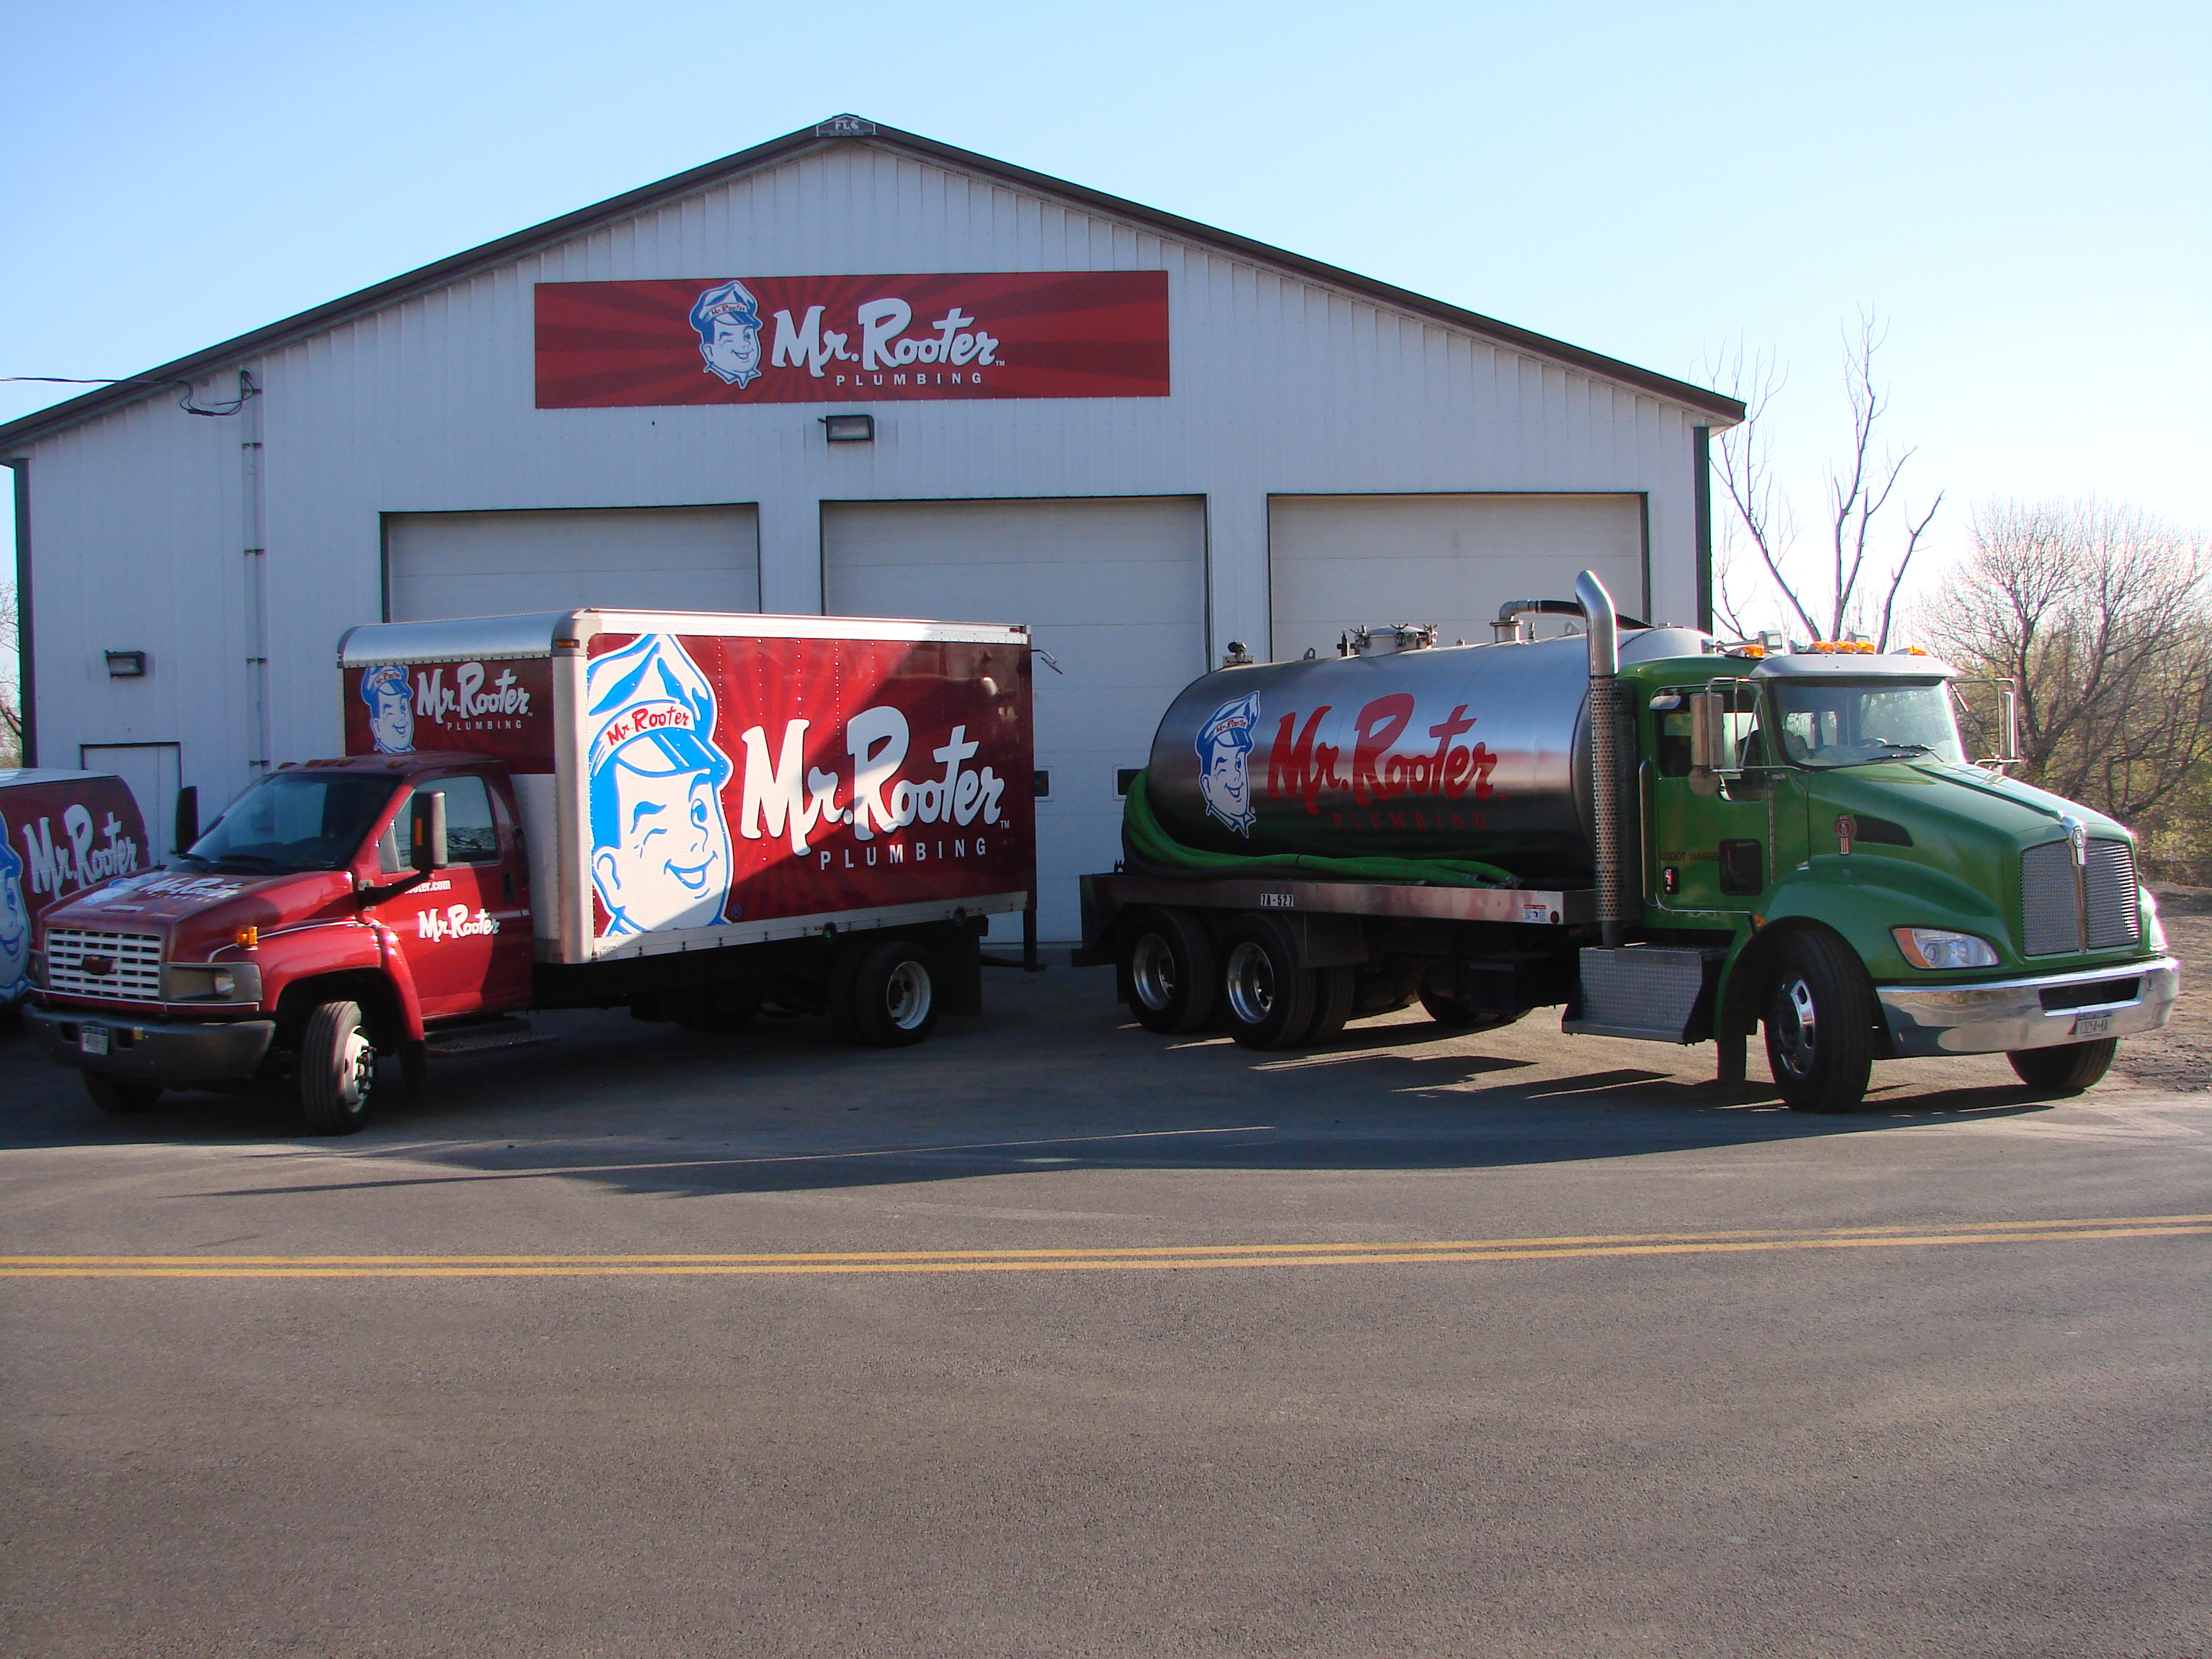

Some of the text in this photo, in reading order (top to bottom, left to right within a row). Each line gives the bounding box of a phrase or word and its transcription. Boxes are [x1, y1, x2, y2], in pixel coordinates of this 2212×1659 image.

[771, 305, 860, 378] Mr.
[858, 297, 999, 372] Rooter
[836, 372, 982, 387] PLUMBING
[416, 668, 461, 724] Mr.
[457, 662, 531, 719] Rooter
[447, 720, 522, 731] PLUMBING
[631, 706, 690, 732] Rooter
[1267, 705, 1349, 816] Mr.
[1352, 692, 1498, 807] Rooter
[740, 719, 854, 857] Mr.
[846, 706, 1005, 841] Rooter
[1332, 812, 1488, 830] PLUMBING
[22, 804, 138, 901] Mr. Rooter
[820, 837, 986, 871] PLUMBING
[1659, 852, 1686, 861] USDOT
[417, 903, 501, 943] Mr. Rooter
